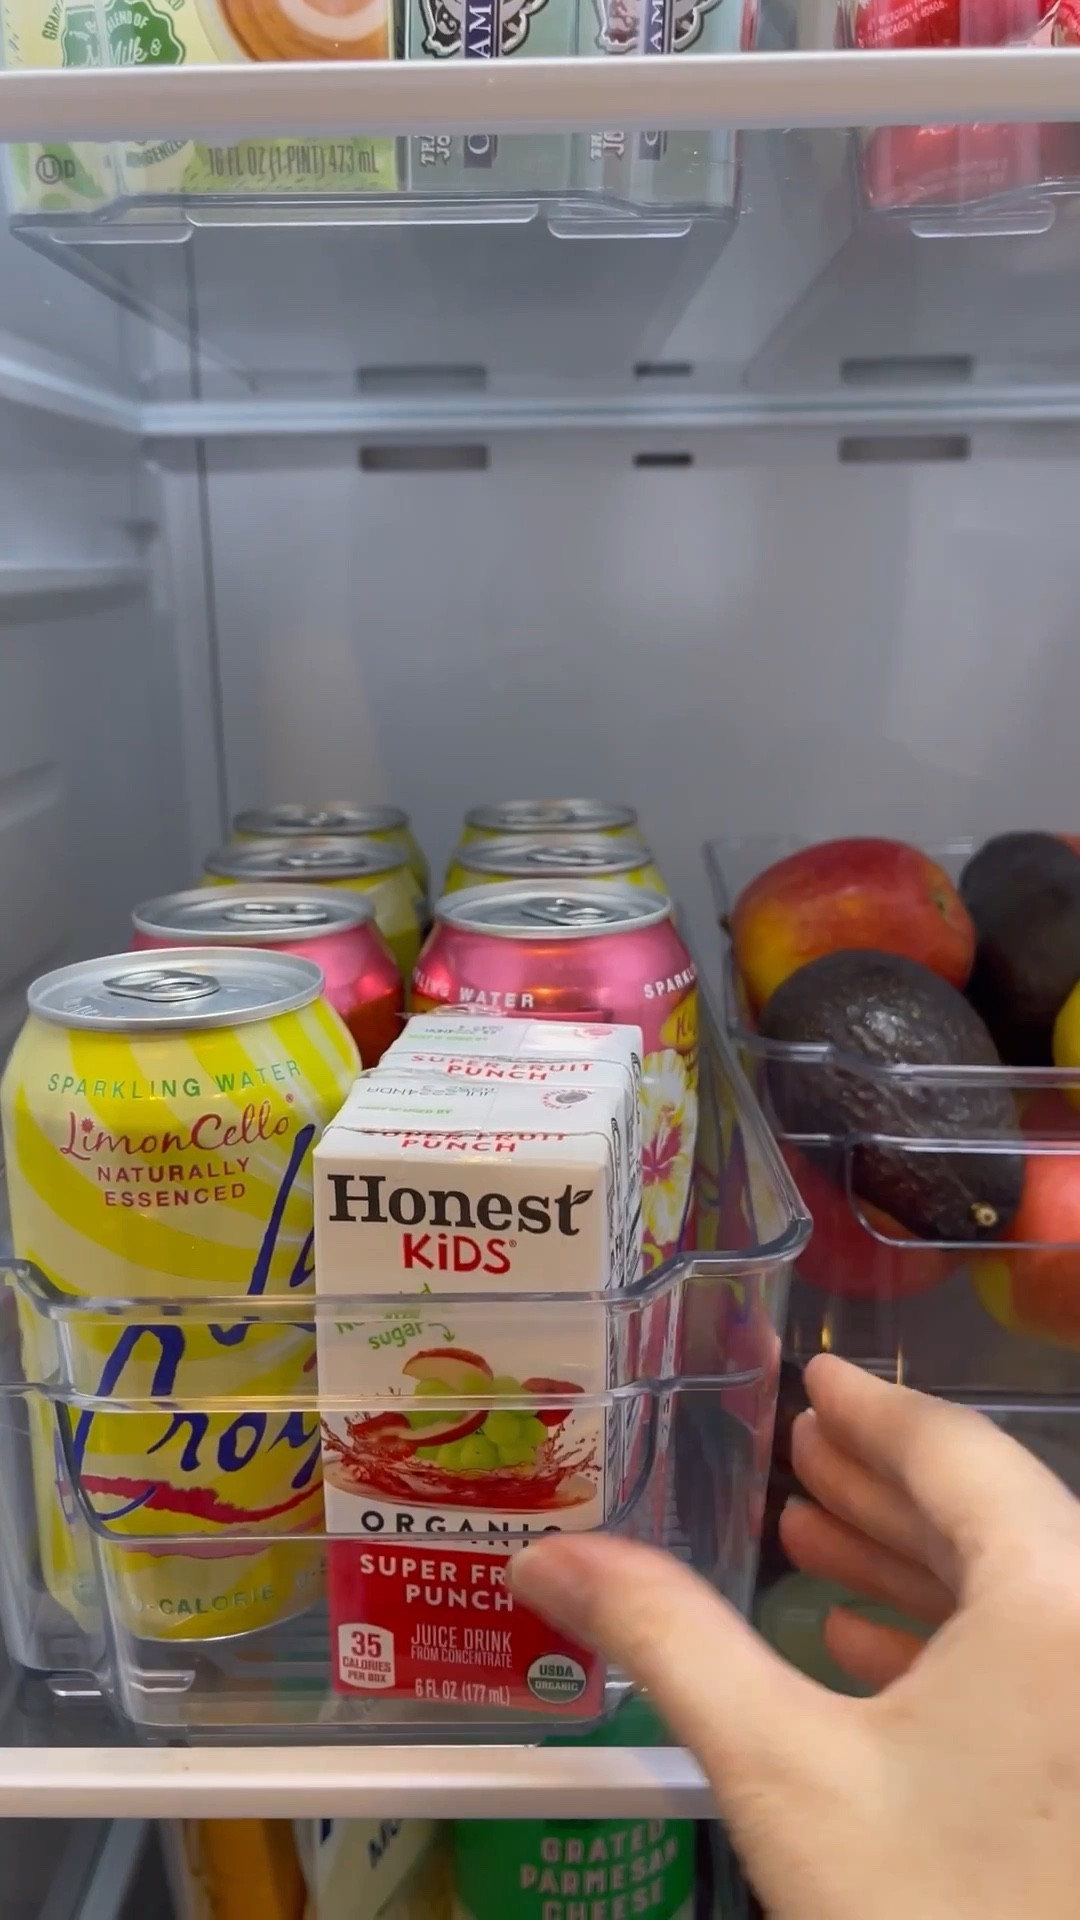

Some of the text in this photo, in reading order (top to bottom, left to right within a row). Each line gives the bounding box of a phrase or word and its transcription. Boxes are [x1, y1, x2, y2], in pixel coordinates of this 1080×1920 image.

[134, 13, 149, 29] OF
[208, 148, 225, 176] 16
[227, 147, 243, 176] FL
[247, 146, 265, 176] OZ
[328, 145, 355, 175] 473
[358, 145, 379, 174] mL
[644, 965, 696, 1000] SPARKL
[460, 987, 534, 1008] WATER
[411, 1055, 594, 1073] SUPER FRUIT
[446, 1066, 548, 1081] PUNCH
[48, 1059, 302, 1098] SPARKLING WATER
[60, 1100, 289, 1161] LimonCello
[401, 1140, 517, 1153] PUNCH
[98, 1157, 250, 1182] NATURALLY
[104, 1183, 246, 1208] ESSENCED
[327, 1173, 594, 1237] Honest
[368, 1321, 424, 1350] sugar
[361, 1510, 562, 1548] ORGANI
[360, 1554, 457, 1583] SUPER
[405, 1584, 514, 1612] PUNCH
[351, 1630, 382, 1658] 35
[411, 1623, 512, 1653] JUICE DRINK
[342, 1655, 391, 1673] CALORIES
[411, 1645, 513, 1669] FROM CONCENTRATE
[539, 1664, 574, 1678] USDA
[348, 1670, 387, 1683] PER BOX
[535, 1680, 579, 1692] ORGANIC
[415, 1678, 511, 1706] 6 FL OZ (177 mL)
[540, 1818, 664, 1864] GRATED
